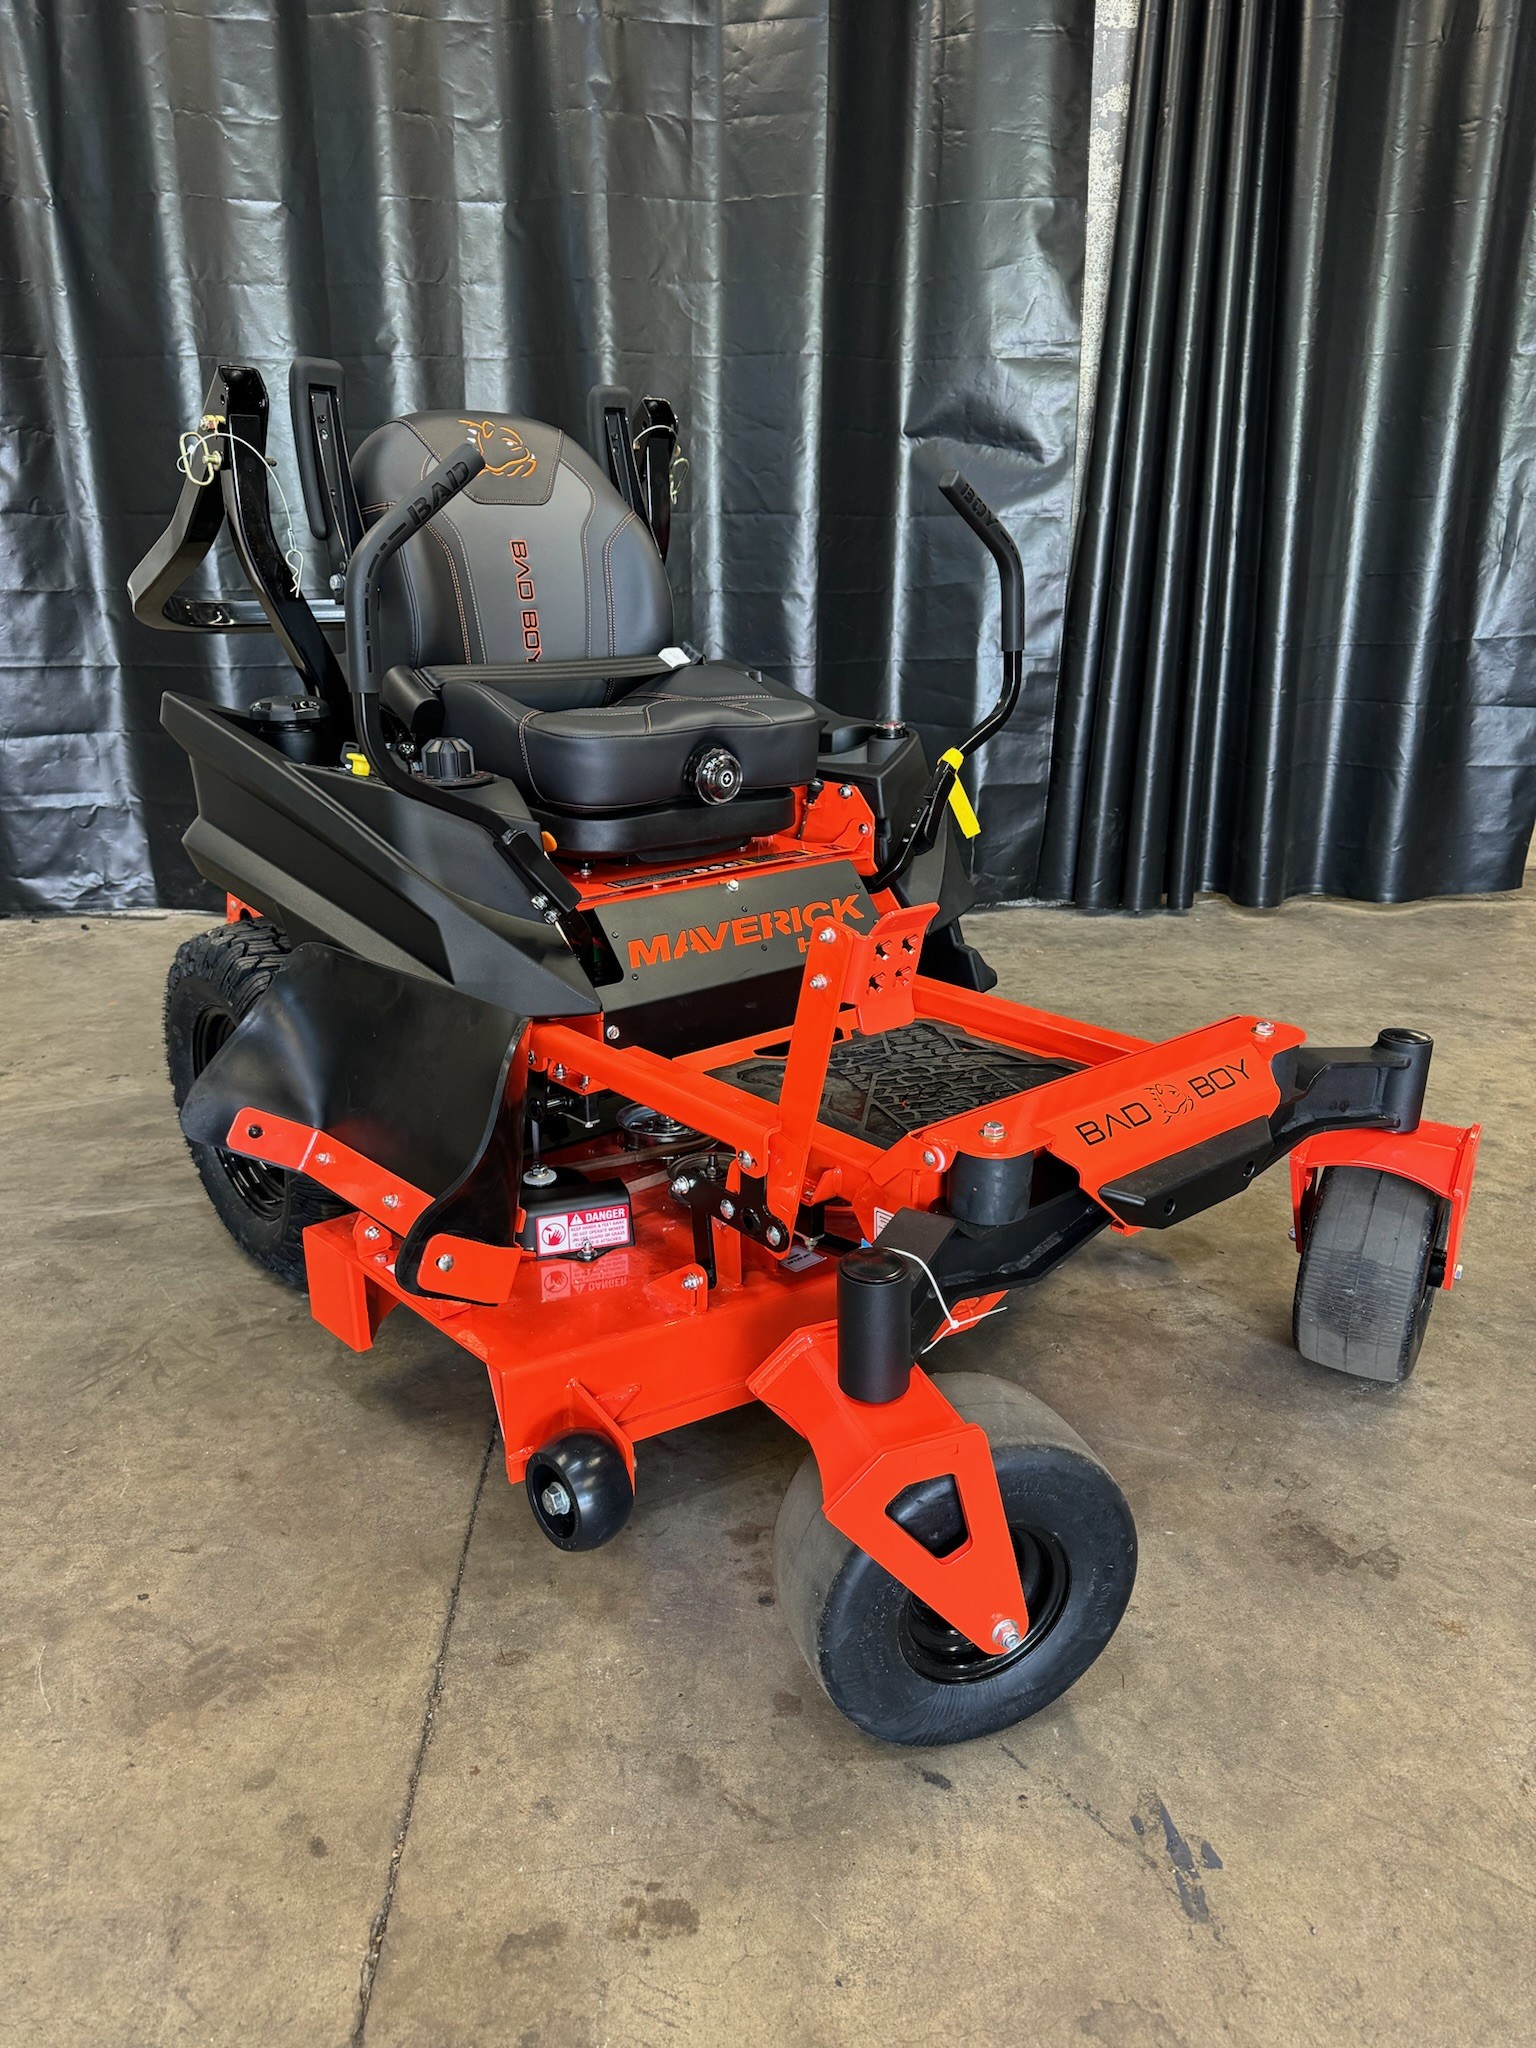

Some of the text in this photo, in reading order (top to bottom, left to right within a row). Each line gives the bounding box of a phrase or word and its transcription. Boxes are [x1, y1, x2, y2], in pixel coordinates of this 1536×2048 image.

[406, 461, 469, 527] BAD
[960, 483, 999, 527] BOY
[509, 540, 535, 601] BAD
[627, 893, 865, 969] MAVERICK
[1075, 1058, 1250, 1146] BAD BOY
[585, 1208, 625, 1223] DANGER
